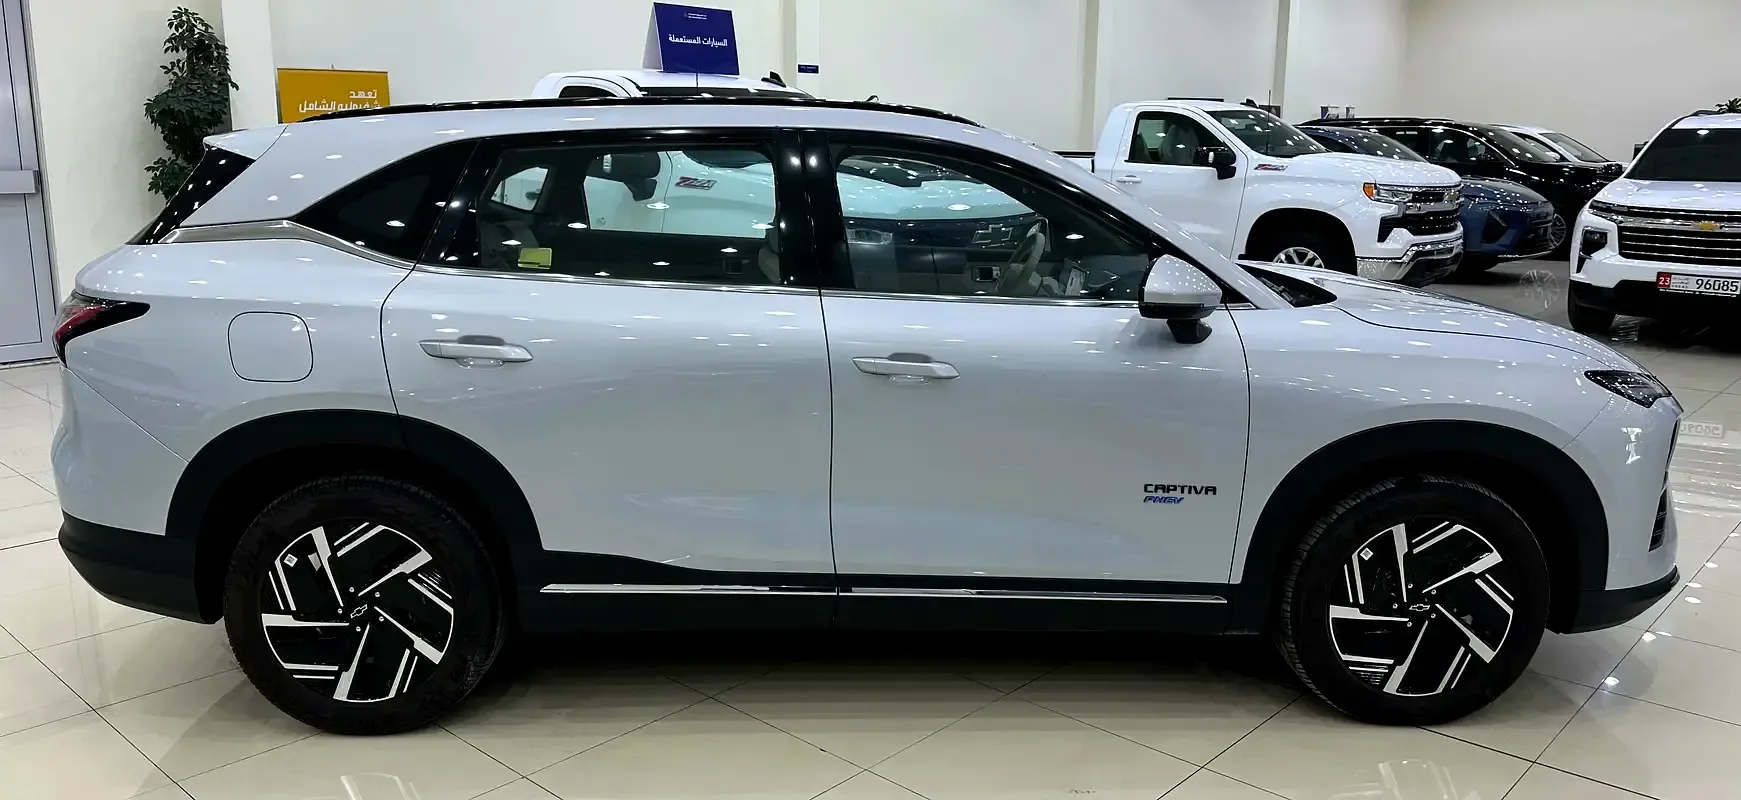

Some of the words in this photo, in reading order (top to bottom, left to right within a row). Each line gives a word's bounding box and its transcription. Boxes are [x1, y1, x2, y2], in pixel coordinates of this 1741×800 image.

[668, 33, 701, 44] المستعملة
[702, 36, 728, 48] السيارات
[349, 89, 378, 99] تعهد
[298, 98, 336, 113] الشامل
[1658, 276, 1671, 286] 23
[1695, 278, 1740, 292] 96085
[1143, 483, 1217, 496] CAPTIVA
[1143, 495, 1185, 504] PHEV
